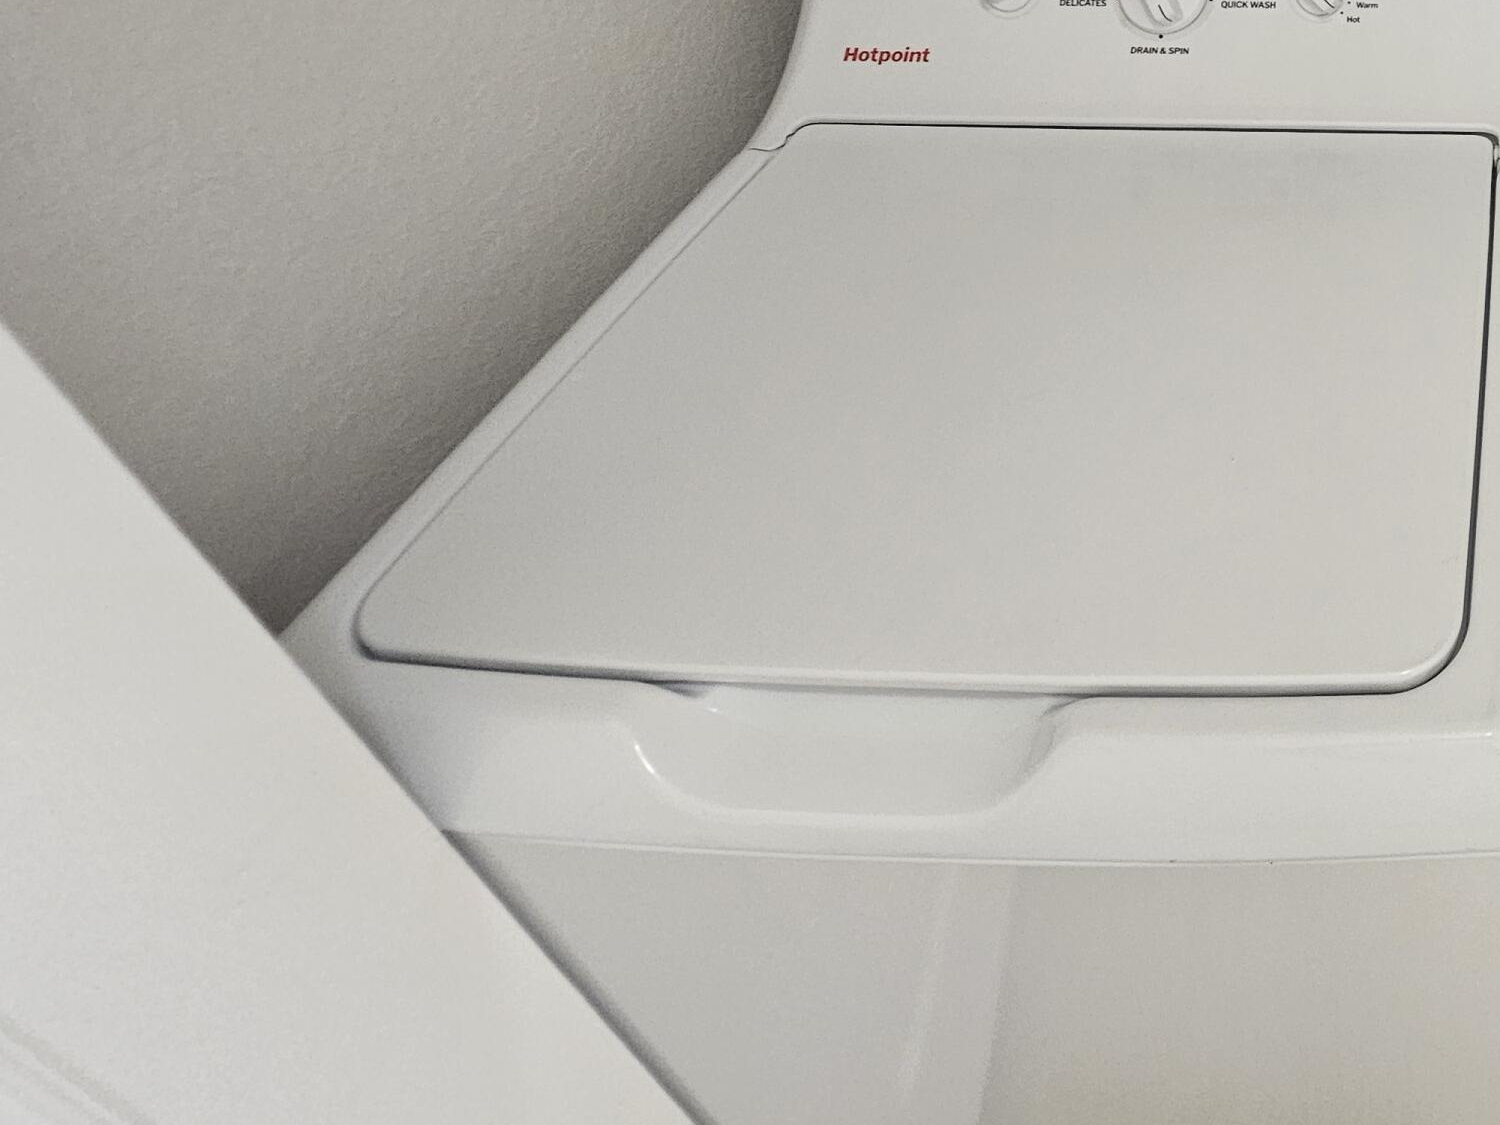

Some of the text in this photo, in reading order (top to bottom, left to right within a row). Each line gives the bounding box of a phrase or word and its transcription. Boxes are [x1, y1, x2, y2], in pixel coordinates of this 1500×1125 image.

[1221, 0, 1276, 9] QUICK WASH
[1356, 1, 1379, 9] Warm
[1346, 15, 1361, 23] Hot
[1130, 46, 1190, 55] DRAIN & SPIN
[842, 46, 930, 66] Hotpoint
